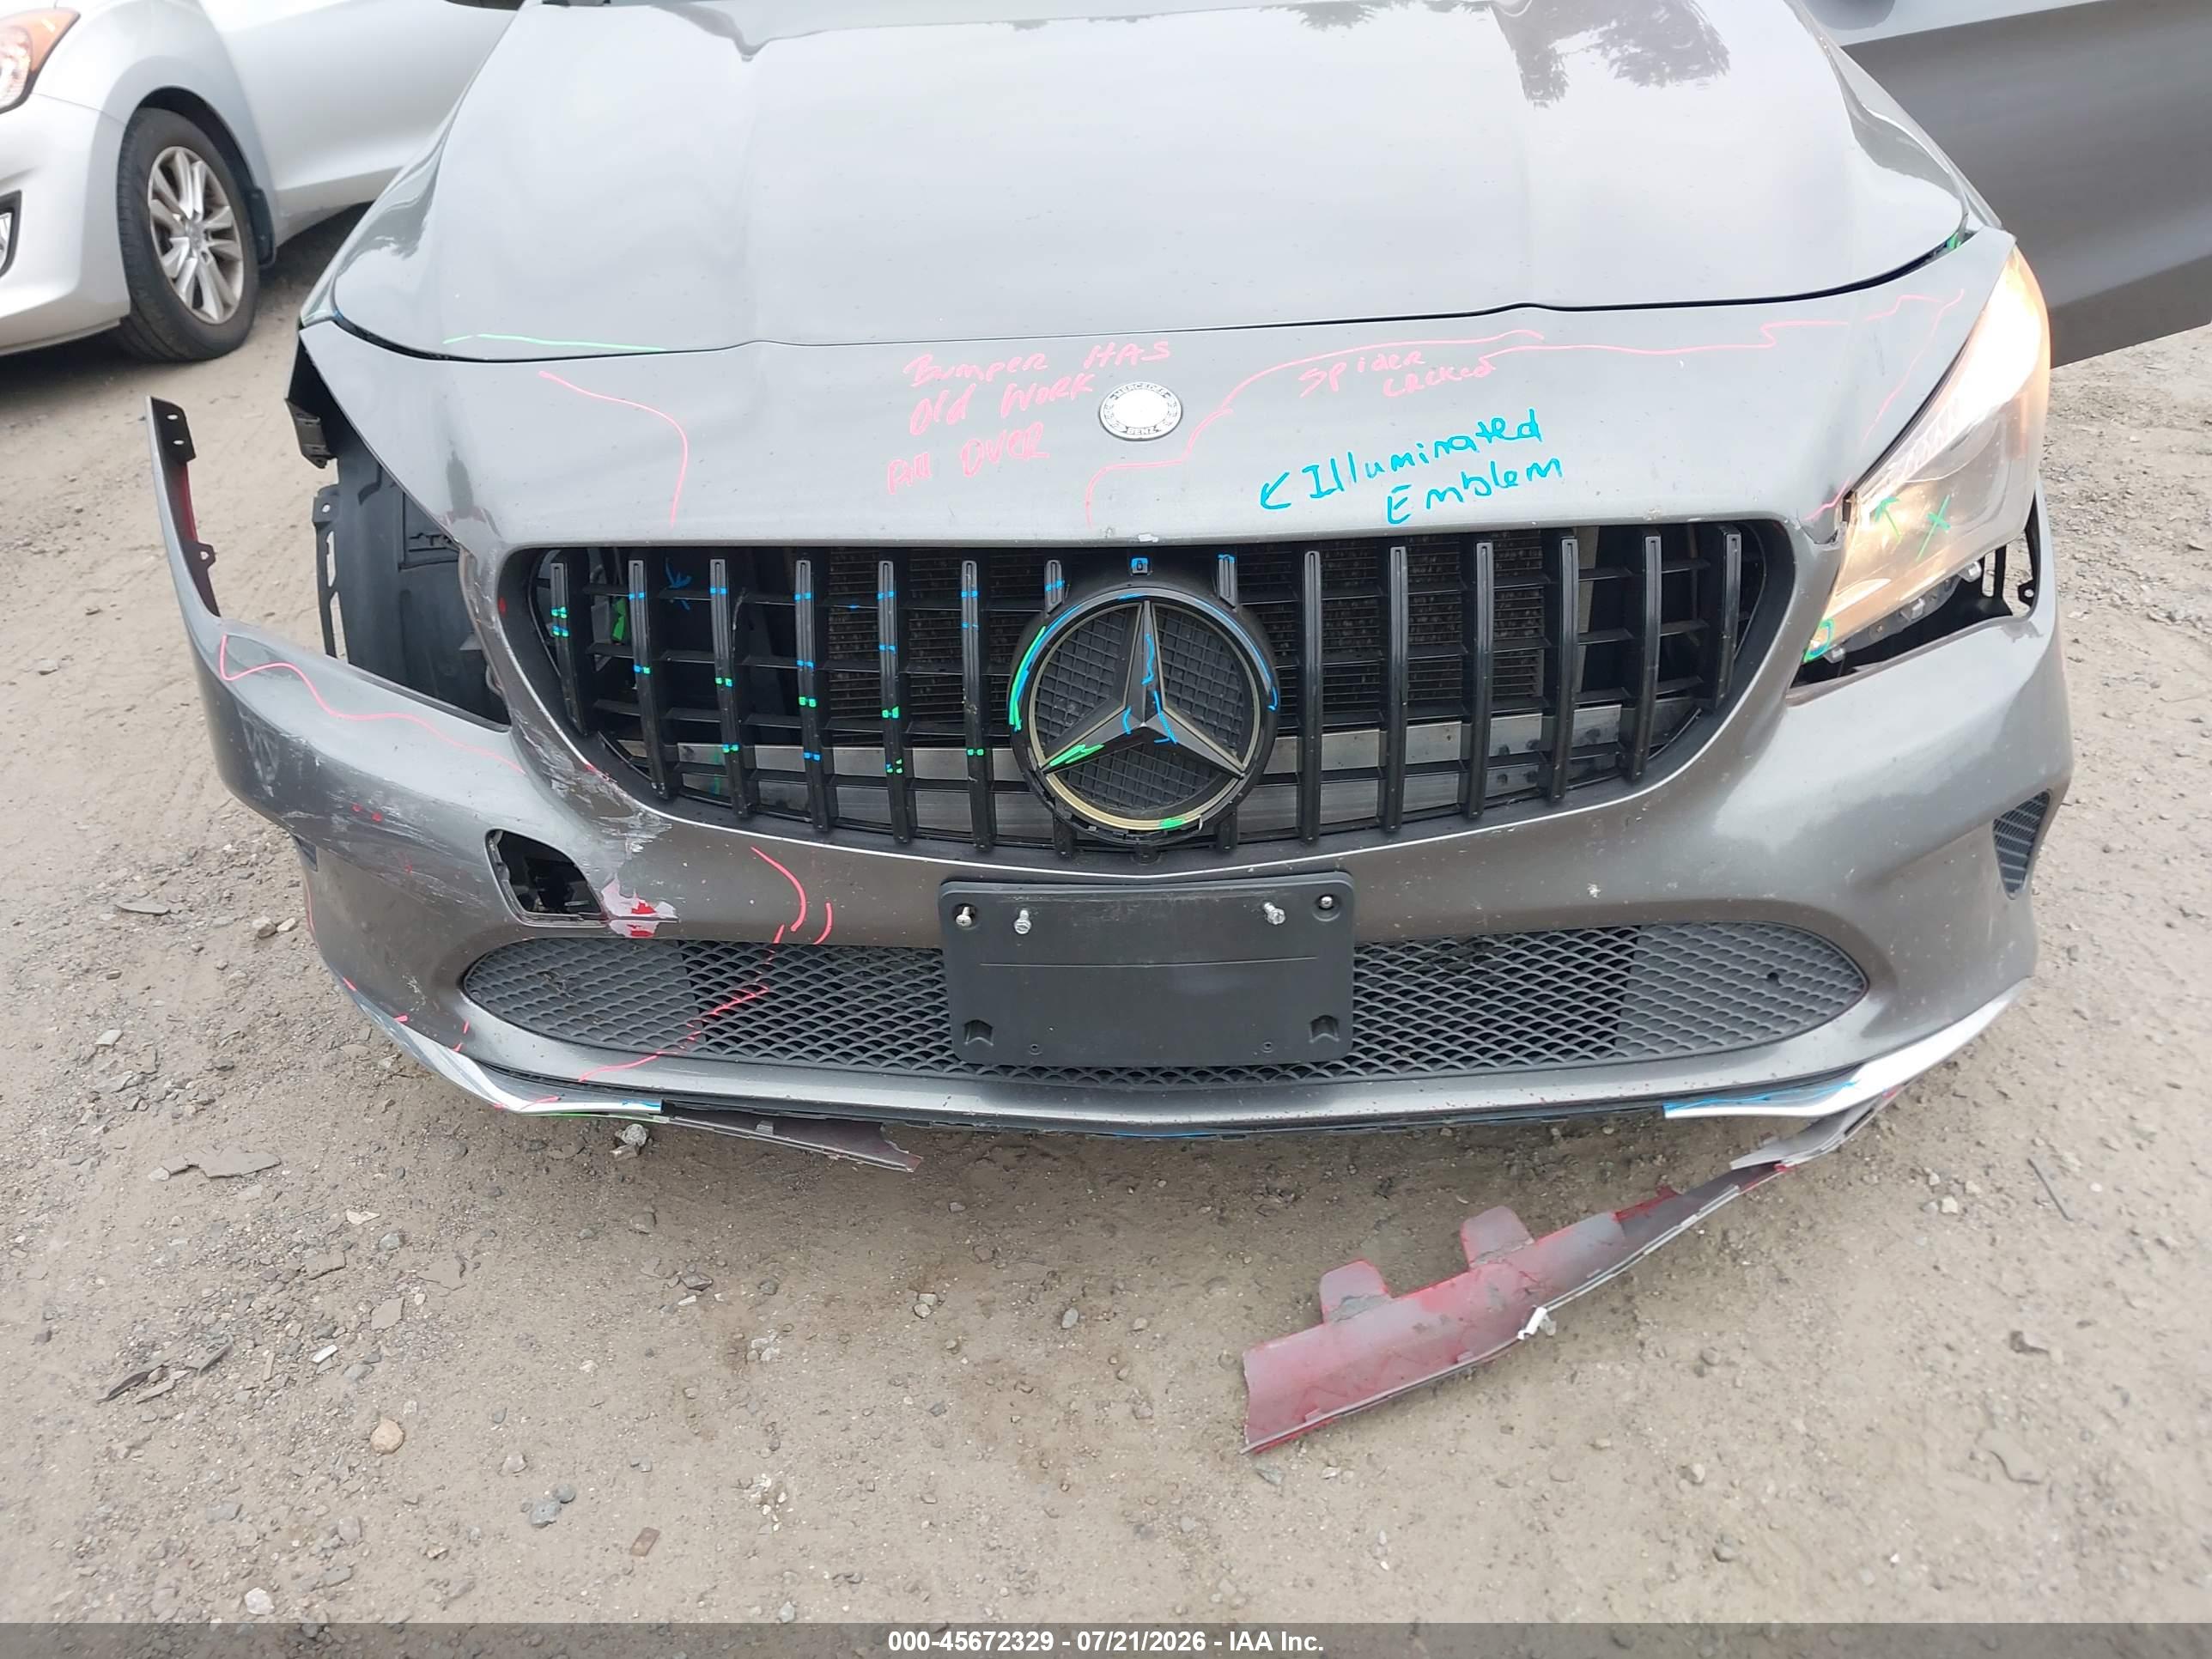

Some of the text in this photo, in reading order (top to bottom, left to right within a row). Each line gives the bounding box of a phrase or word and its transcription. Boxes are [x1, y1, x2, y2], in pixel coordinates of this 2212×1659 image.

[1083, 341, 1171, 369] HAS
[909, 383, 976, 435] Old
[1126, 427, 1157, 435] BENZ
[1301, 408, 1543, 499] Illuminated
[1387, 458, 1563, 525] Emblem
